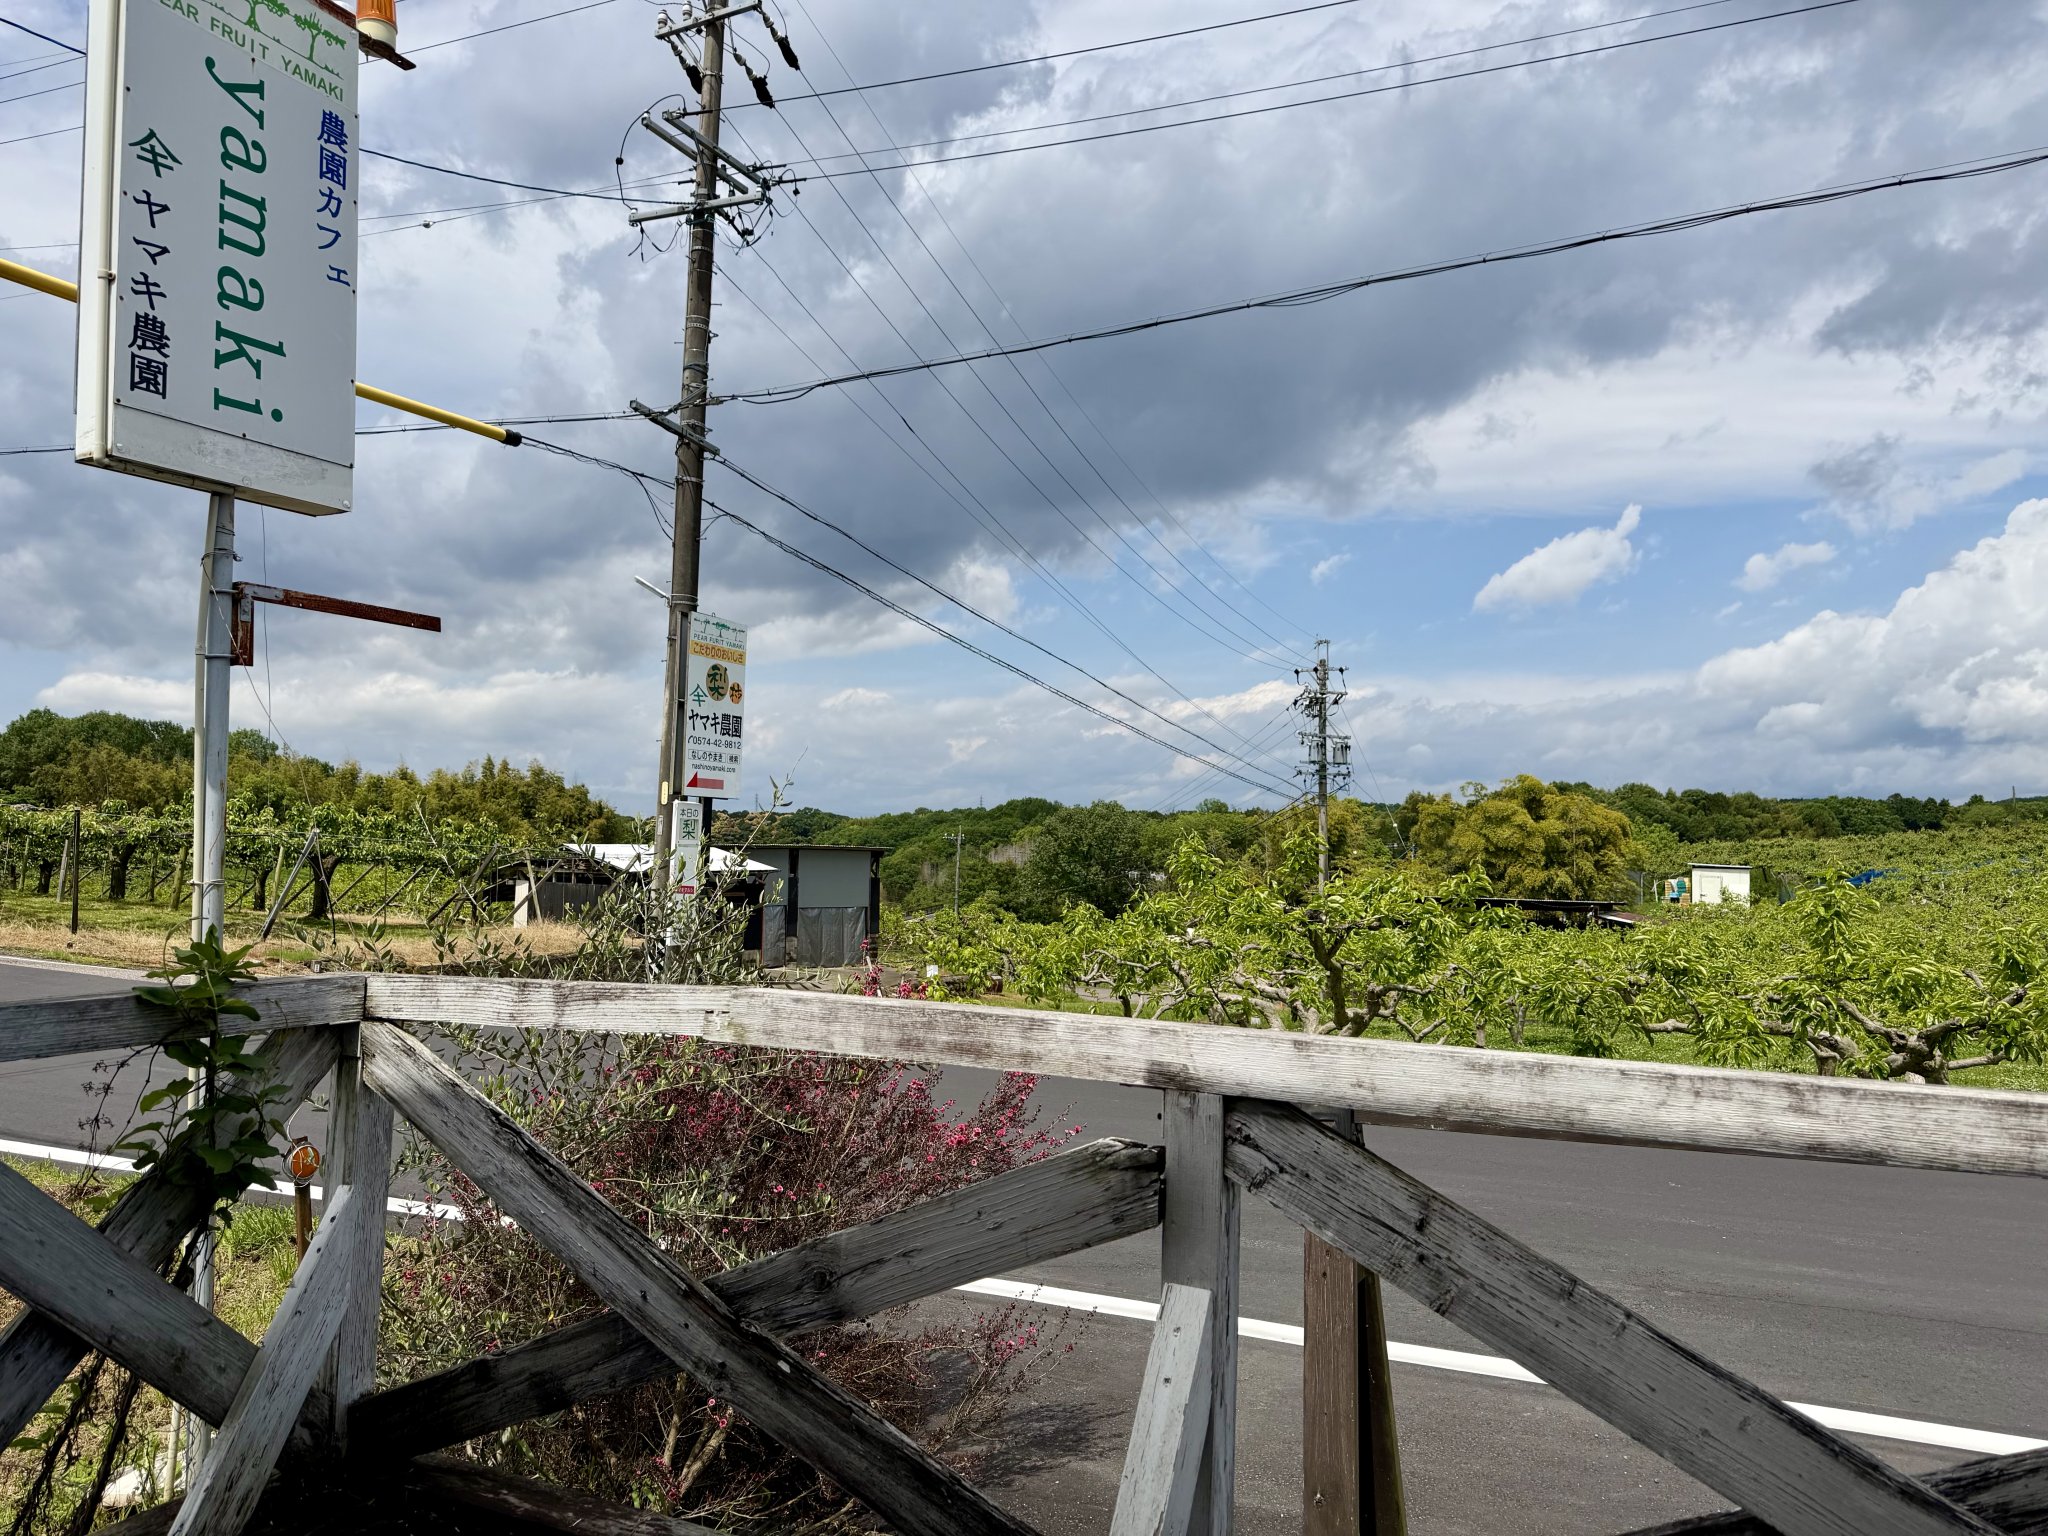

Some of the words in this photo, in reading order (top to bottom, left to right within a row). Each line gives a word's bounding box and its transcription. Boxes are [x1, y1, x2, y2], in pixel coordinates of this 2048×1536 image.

[210, 16, 269, 60] FRUIT
[281, 55, 344, 102] YAMAKI
[316, 109, 351, 287] 農園カフェ
[204, 56, 287, 423] yamaki
[693, 633, 708, 642] PEAR
[726, 641, 745, 651] YAMAKI
[693, 642, 744, 664] こだわりのおいしさ
[707, 664, 728, 699] 梨
[688, 709, 743, 739] ヤマキ農園
[692, 736, 742, 749] 0574-42-9812
[691, 751, 723, 762] なしのやまき
[680, 808, 699, 818] 本日の
[682, 819, 696, 840] 梨
